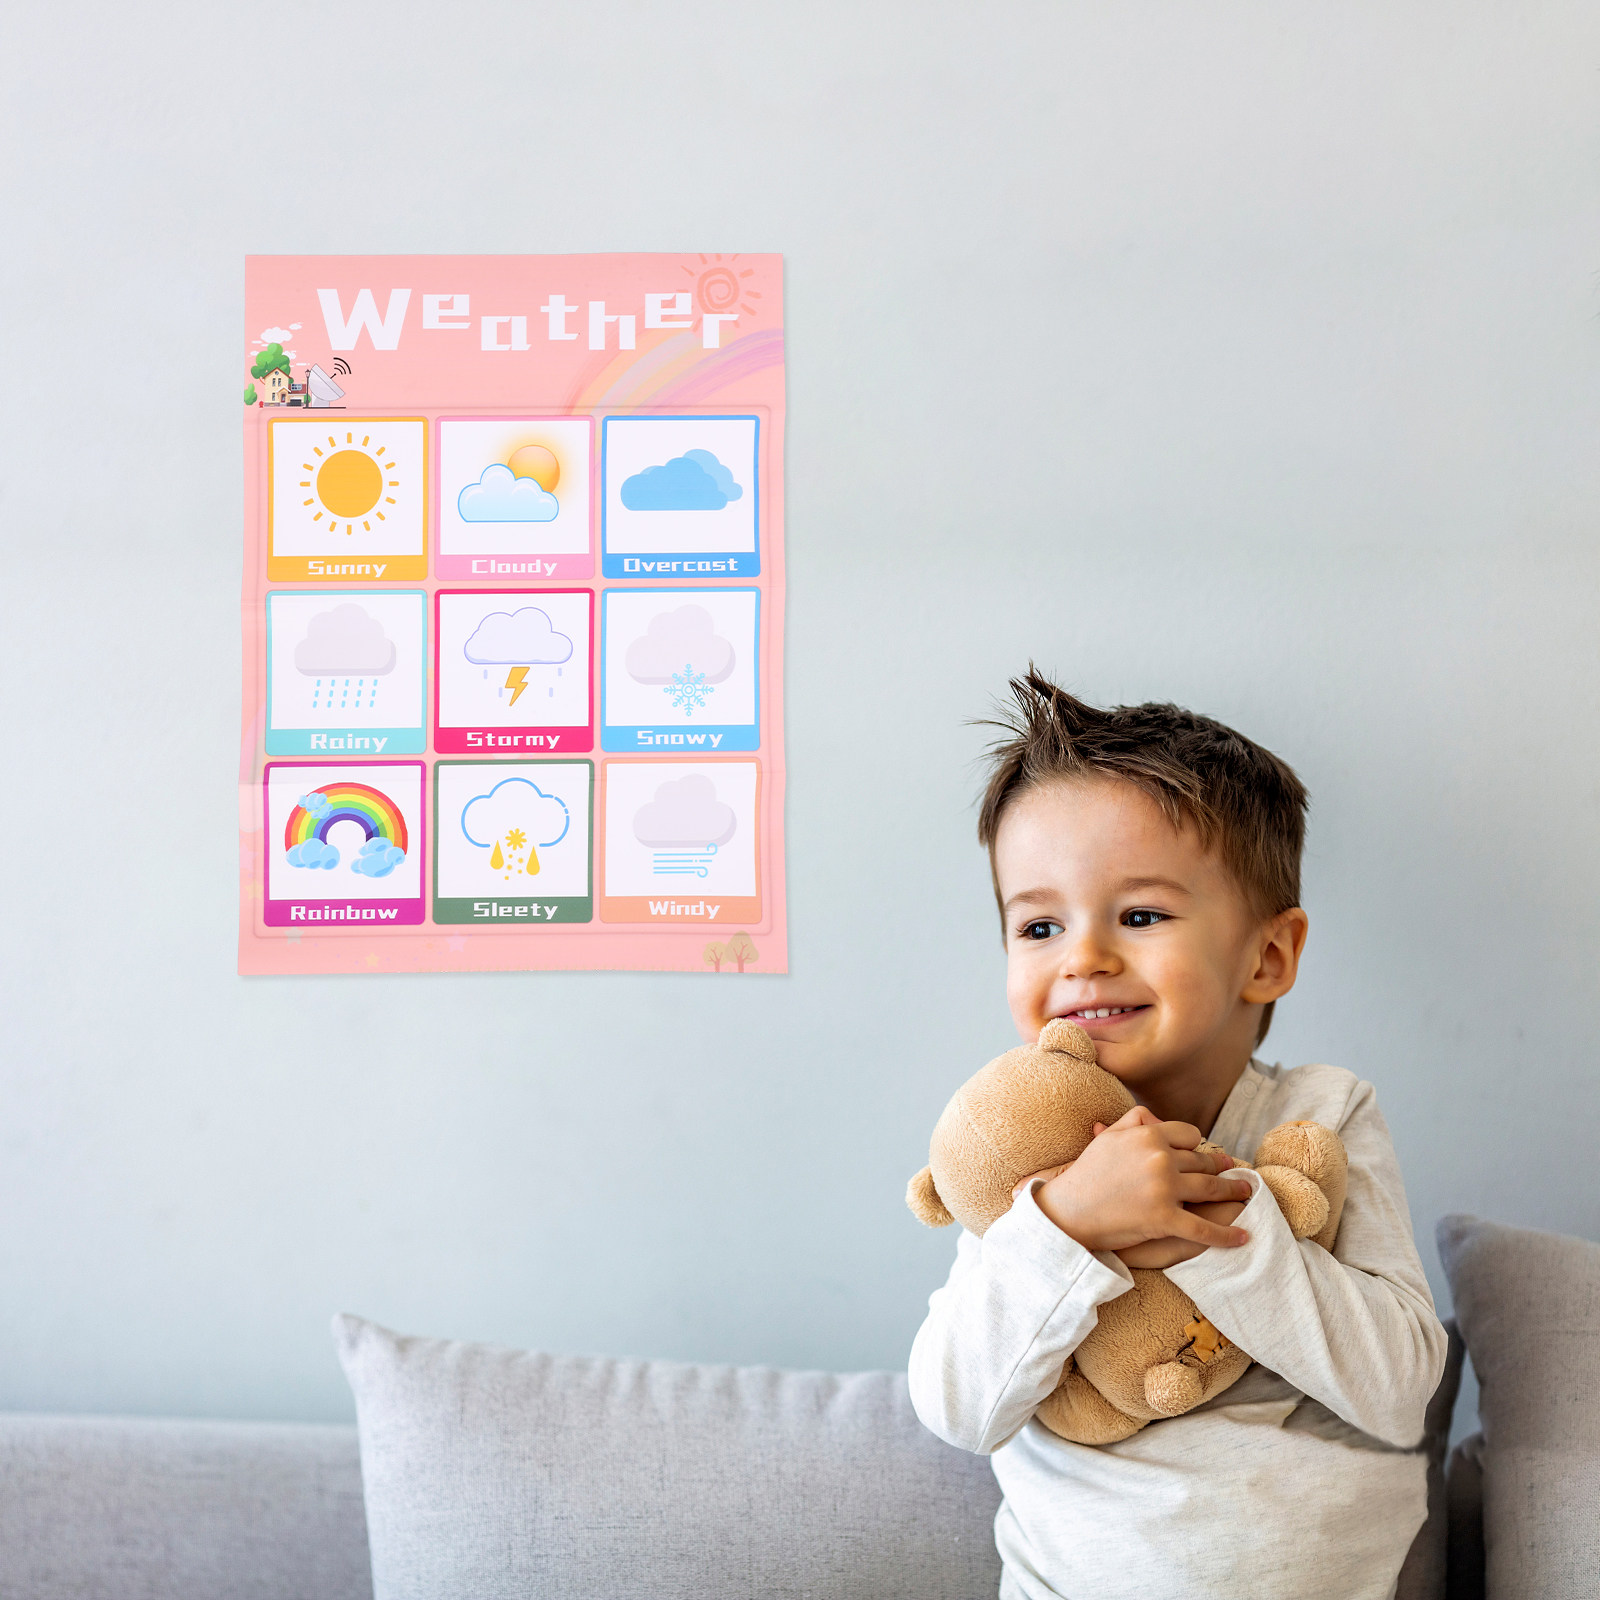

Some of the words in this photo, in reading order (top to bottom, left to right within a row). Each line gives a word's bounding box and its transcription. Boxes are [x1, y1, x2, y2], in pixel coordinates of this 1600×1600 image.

[316, 288, 740, 351] Weather
[307, 560, 387, 578] Sunny
[471, 559, 558, 577] Cloudy
[623, 556, 738, 573] Overcast
[310, 733, 388, 753] Rainy
[466, 731, 561, 750] Stormy
[637, 730, 724, 748] Snowy
[290, 905, 399, 922] Rainbow
[473, 902, 559, 920] Sleety
[648, 900, 721, 920] Windy
